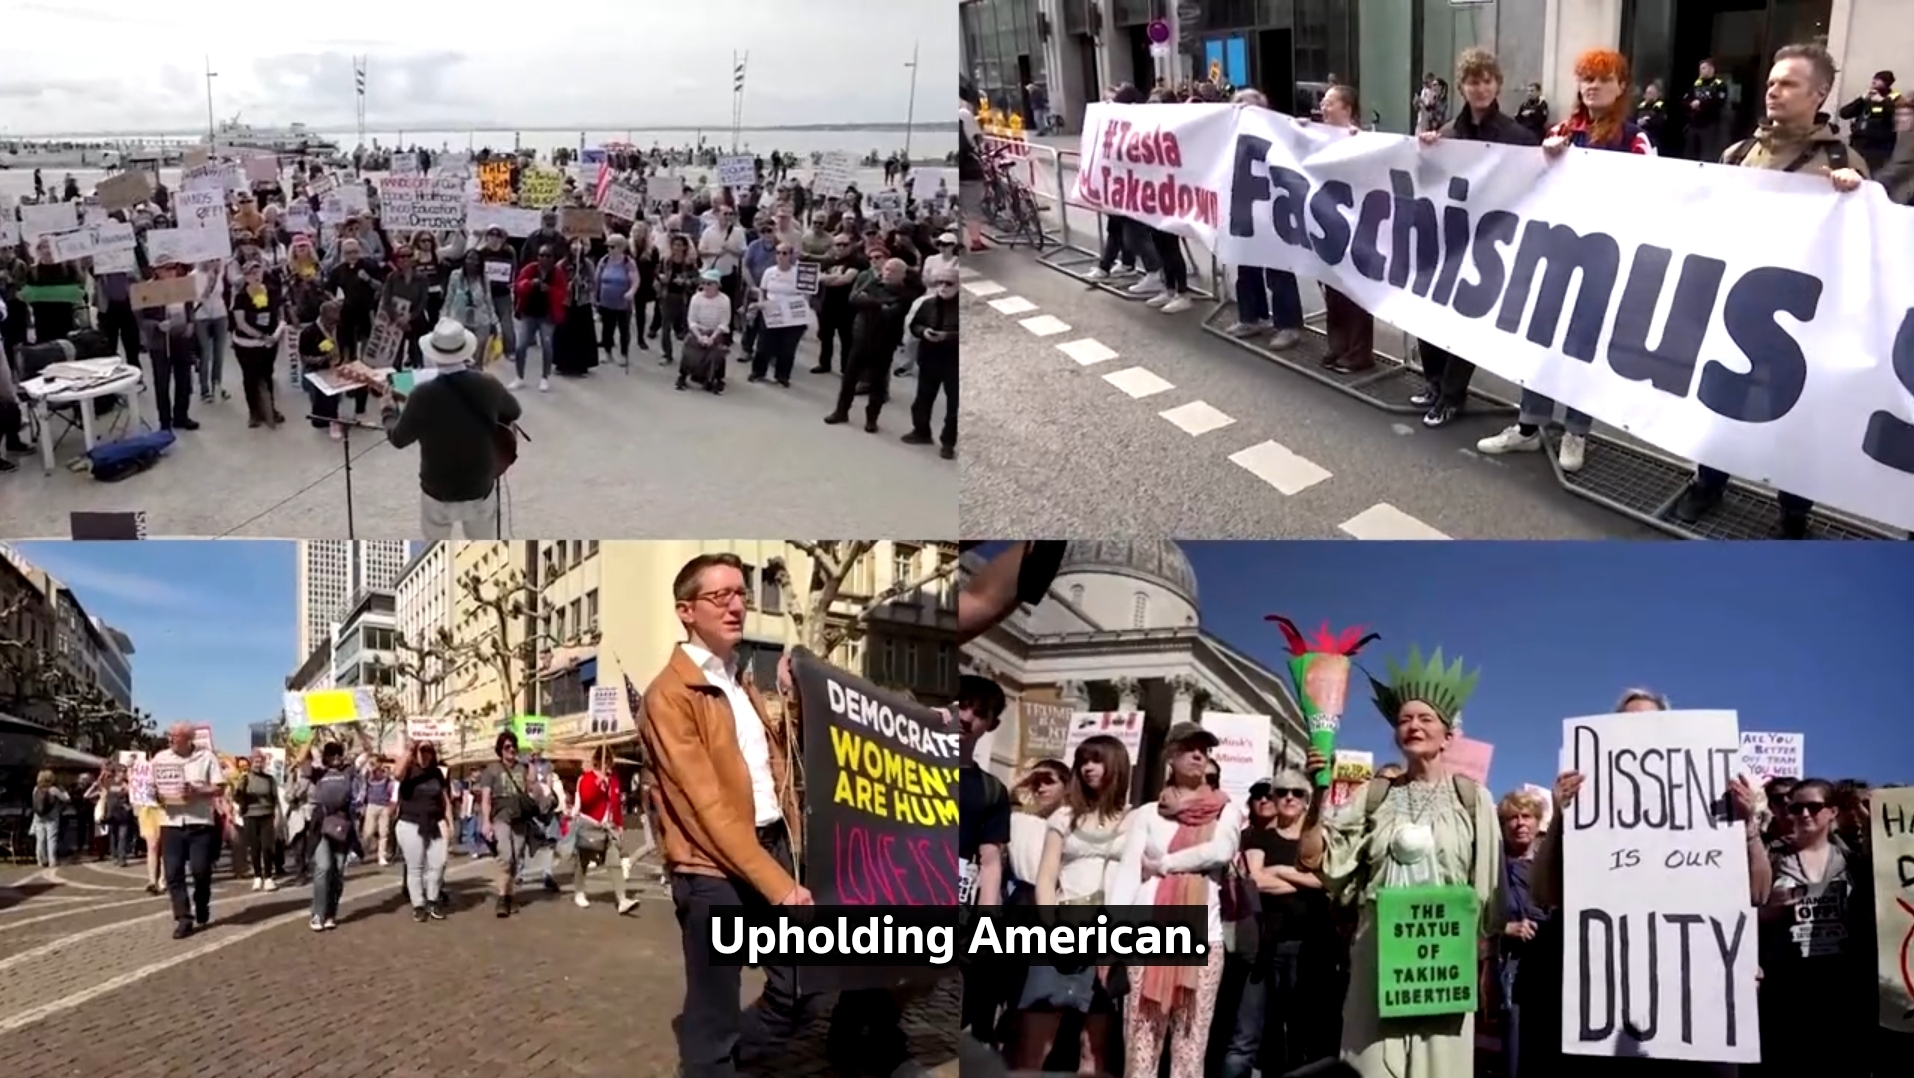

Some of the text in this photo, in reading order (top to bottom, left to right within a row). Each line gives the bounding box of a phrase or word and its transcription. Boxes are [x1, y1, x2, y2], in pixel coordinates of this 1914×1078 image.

[1103, 119, 1182, 168] #Tesla
[1101, 166, 1218, 229] Takedown
[1230, 134, 1823, 423] Faschismus
[826, 678, 959, 758] DEMOCRATS
[1217, 753, 1253, 763] Minion
[1574, 726, 1739, 830] DISSENT
[834, 770, 888, 817] ARE
[835, 820, 922, 906] LOVE
[1609, 849, 1641, 870] IS
[1394, 922, 1460, 938] STATUE
[1411, 904, 1445, 919] THE
[1393, 965, 1459, 983] TAKING
[1417, 944, 1440, 959] OF
[1385, 986, 1471, 1006] LIBERTIES
[1579, 908, 1747, 1047] DUTY
